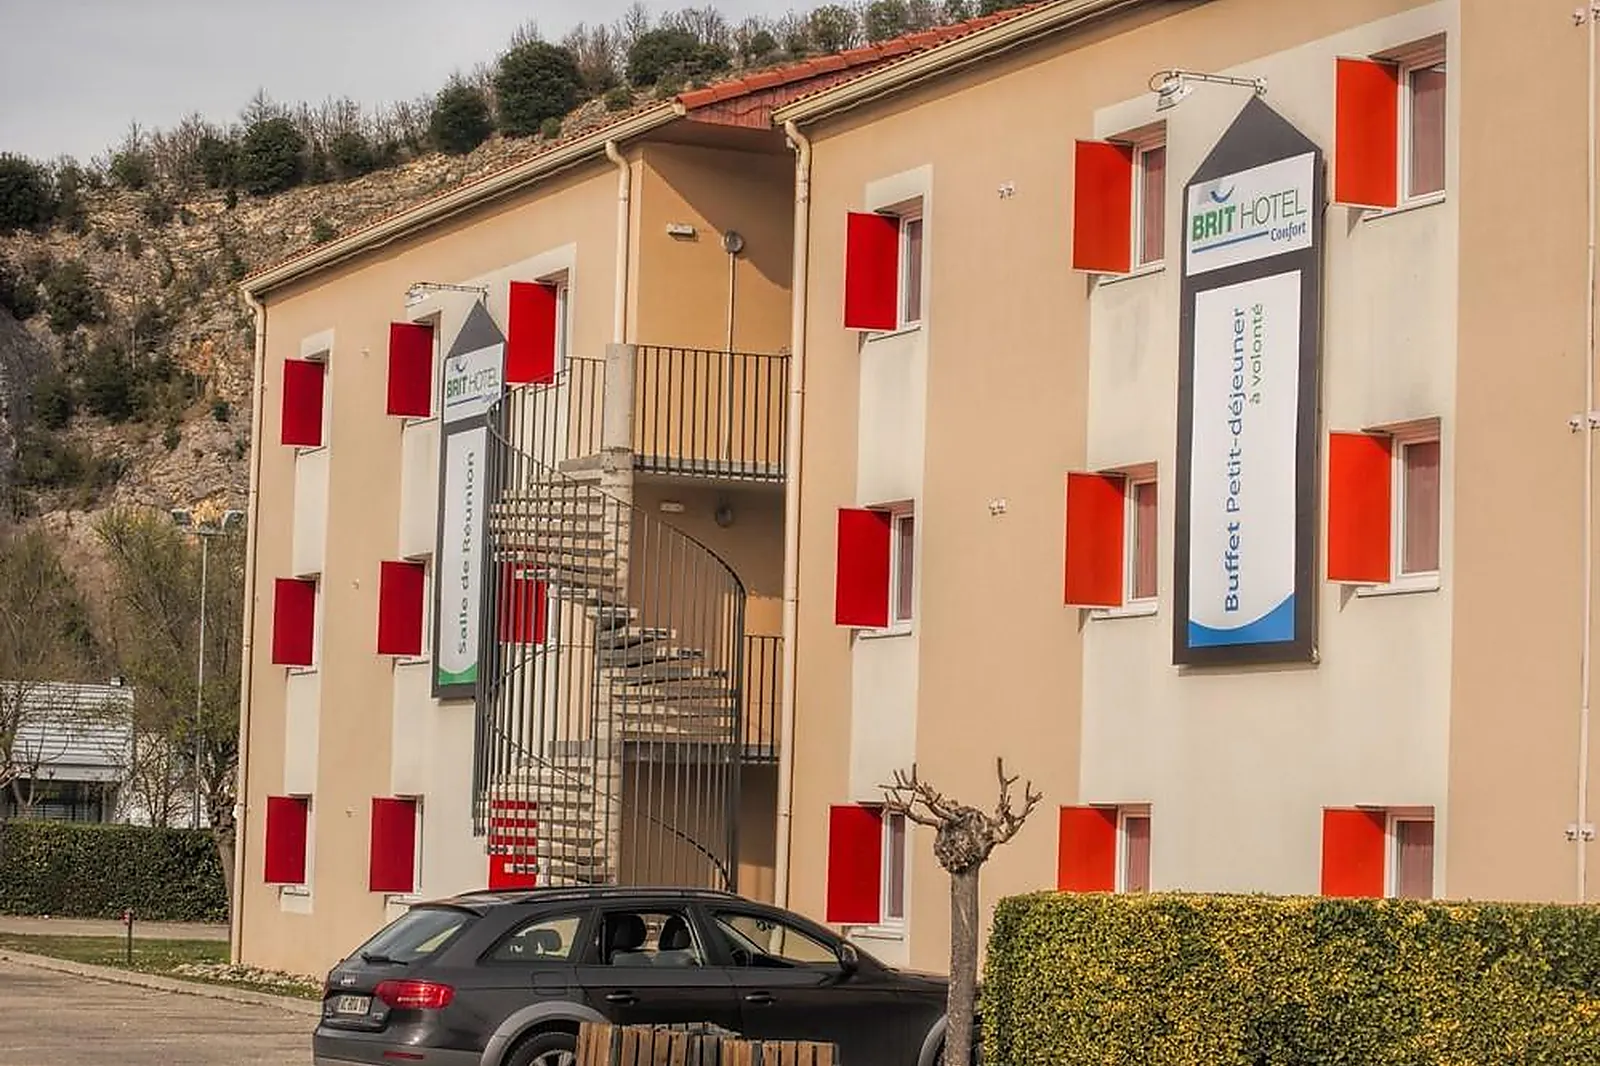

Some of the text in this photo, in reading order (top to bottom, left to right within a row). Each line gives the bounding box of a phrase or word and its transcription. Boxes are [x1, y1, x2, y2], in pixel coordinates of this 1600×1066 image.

[1192, 189, 1307, 242] BRIT HOTEL
[1270, 221, 1307, 242] Confort
[1250, 303, 1264, 387] volonté
[446, 374, 468, 400] BRIT
[468, 364, 500, 396] HOTEL
[1224, 307, 1247, 612] Buffet Petit-déjeuner
[460, 560, 471, 591] de
[458, 597, 469, 655] Salle
